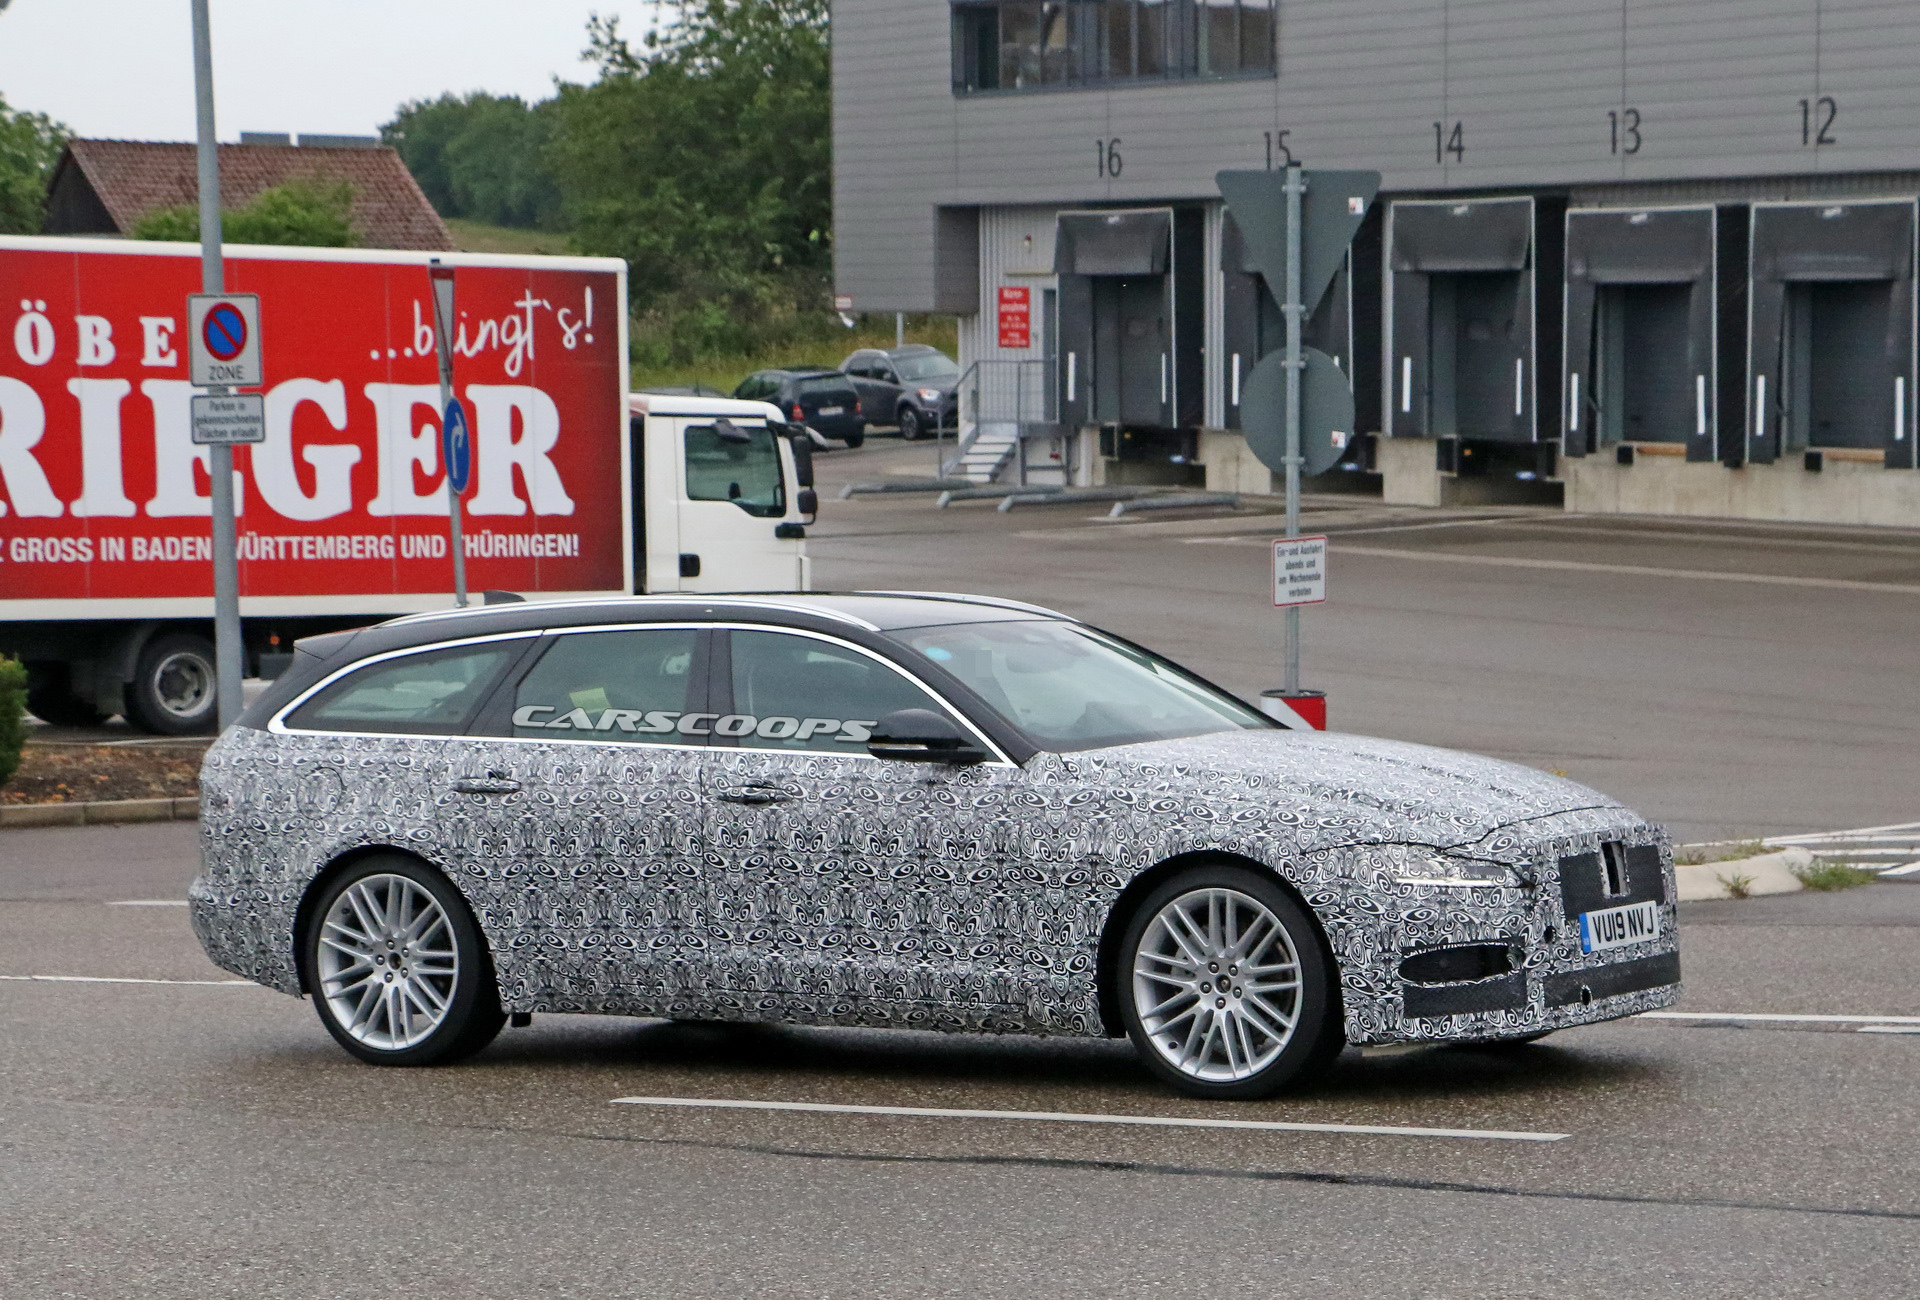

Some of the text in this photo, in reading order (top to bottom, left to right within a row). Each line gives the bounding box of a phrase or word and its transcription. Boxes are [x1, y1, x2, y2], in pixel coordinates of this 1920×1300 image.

[1433, 120, 1466, 164] 14
[1607, 107, 1642, 155] 13
[1798, 96, 1838, 147] 12
[1096, 137, 1123, 178] 16
[1264, 128, 1291, 172] 15
[208, 365, 245, 381] ZONE
[9, 536, 95, 563] GROSS
[100, 536, 126, 562] IN
[400, 534, 447, 559] UND
[461, 529, 580, 558] HÜRINGEN!
[1627, 906, 1654, 938] NVJ
